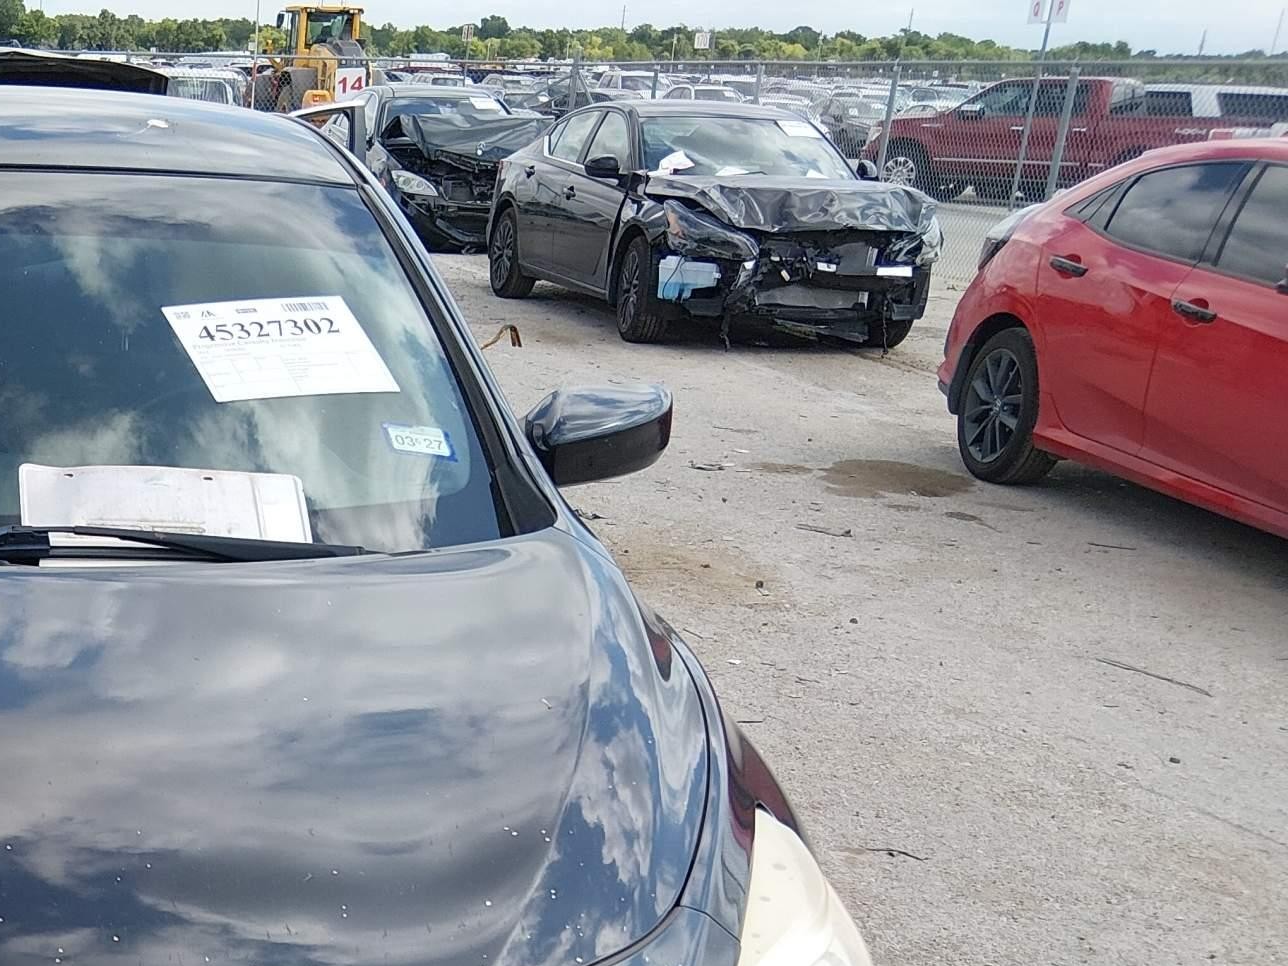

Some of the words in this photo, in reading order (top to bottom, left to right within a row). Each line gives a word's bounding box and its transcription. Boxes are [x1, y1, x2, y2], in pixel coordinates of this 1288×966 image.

[338, 76, 363, 93] 14
[198, 316, 340, 342] 45327302
[423, 438, 442, 450] 27
